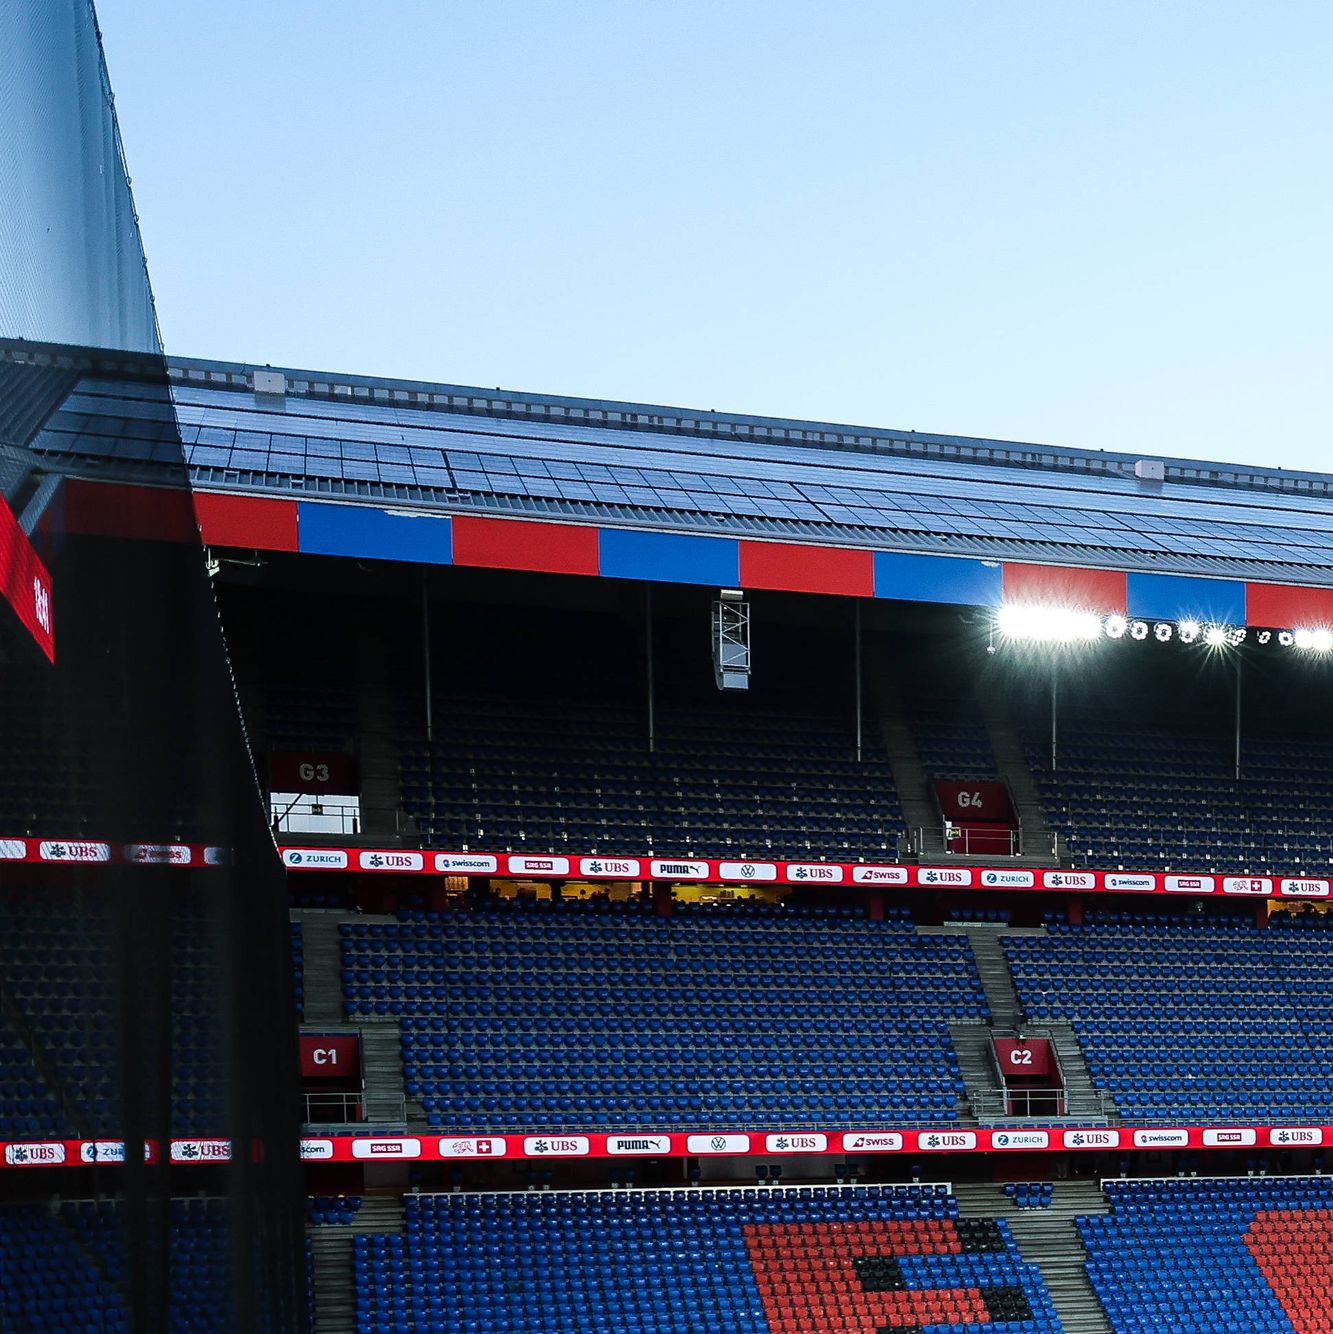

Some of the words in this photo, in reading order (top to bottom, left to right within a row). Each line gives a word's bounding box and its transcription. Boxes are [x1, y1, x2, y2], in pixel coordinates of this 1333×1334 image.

[300, 764, 329, 781] G3
[958, 791, 982, 808] G4
[68, 846, 98, 857] UBS
[306, 855, 342, 863] ZURICH
[385, 856, 413, 866] UBS
[450, 859, 490, 867] swisscom
[604, 863, 630, 872] UBS
[659, 865, 689, 874] PUMA
[809, 869, 833, 878] UBS
[939, 872, 962, 882] UBS
[1064, 876, 1086, 885] UBS
[1118, 878, 1150, 886] swisscom
[1300, 883, 1321, 892] UBS
[314, 1049, 337, 1066] C1
[1010, 1050, 1032, 1065] C2
[941, 1136, 966, 1145] UBS
[1086, 1134, 1110, 1143] UBS
[1148, 1134, 1183, 1142] swisscom
[1291, 1132, 1313, 1141] UBS
[550, 1140, 578, 1152] UBS
[617, 1140, 647, 1150] PUMA
[790, 1138, 816, 1147] UBS
[29, 1146, 55, 1159] UBS
